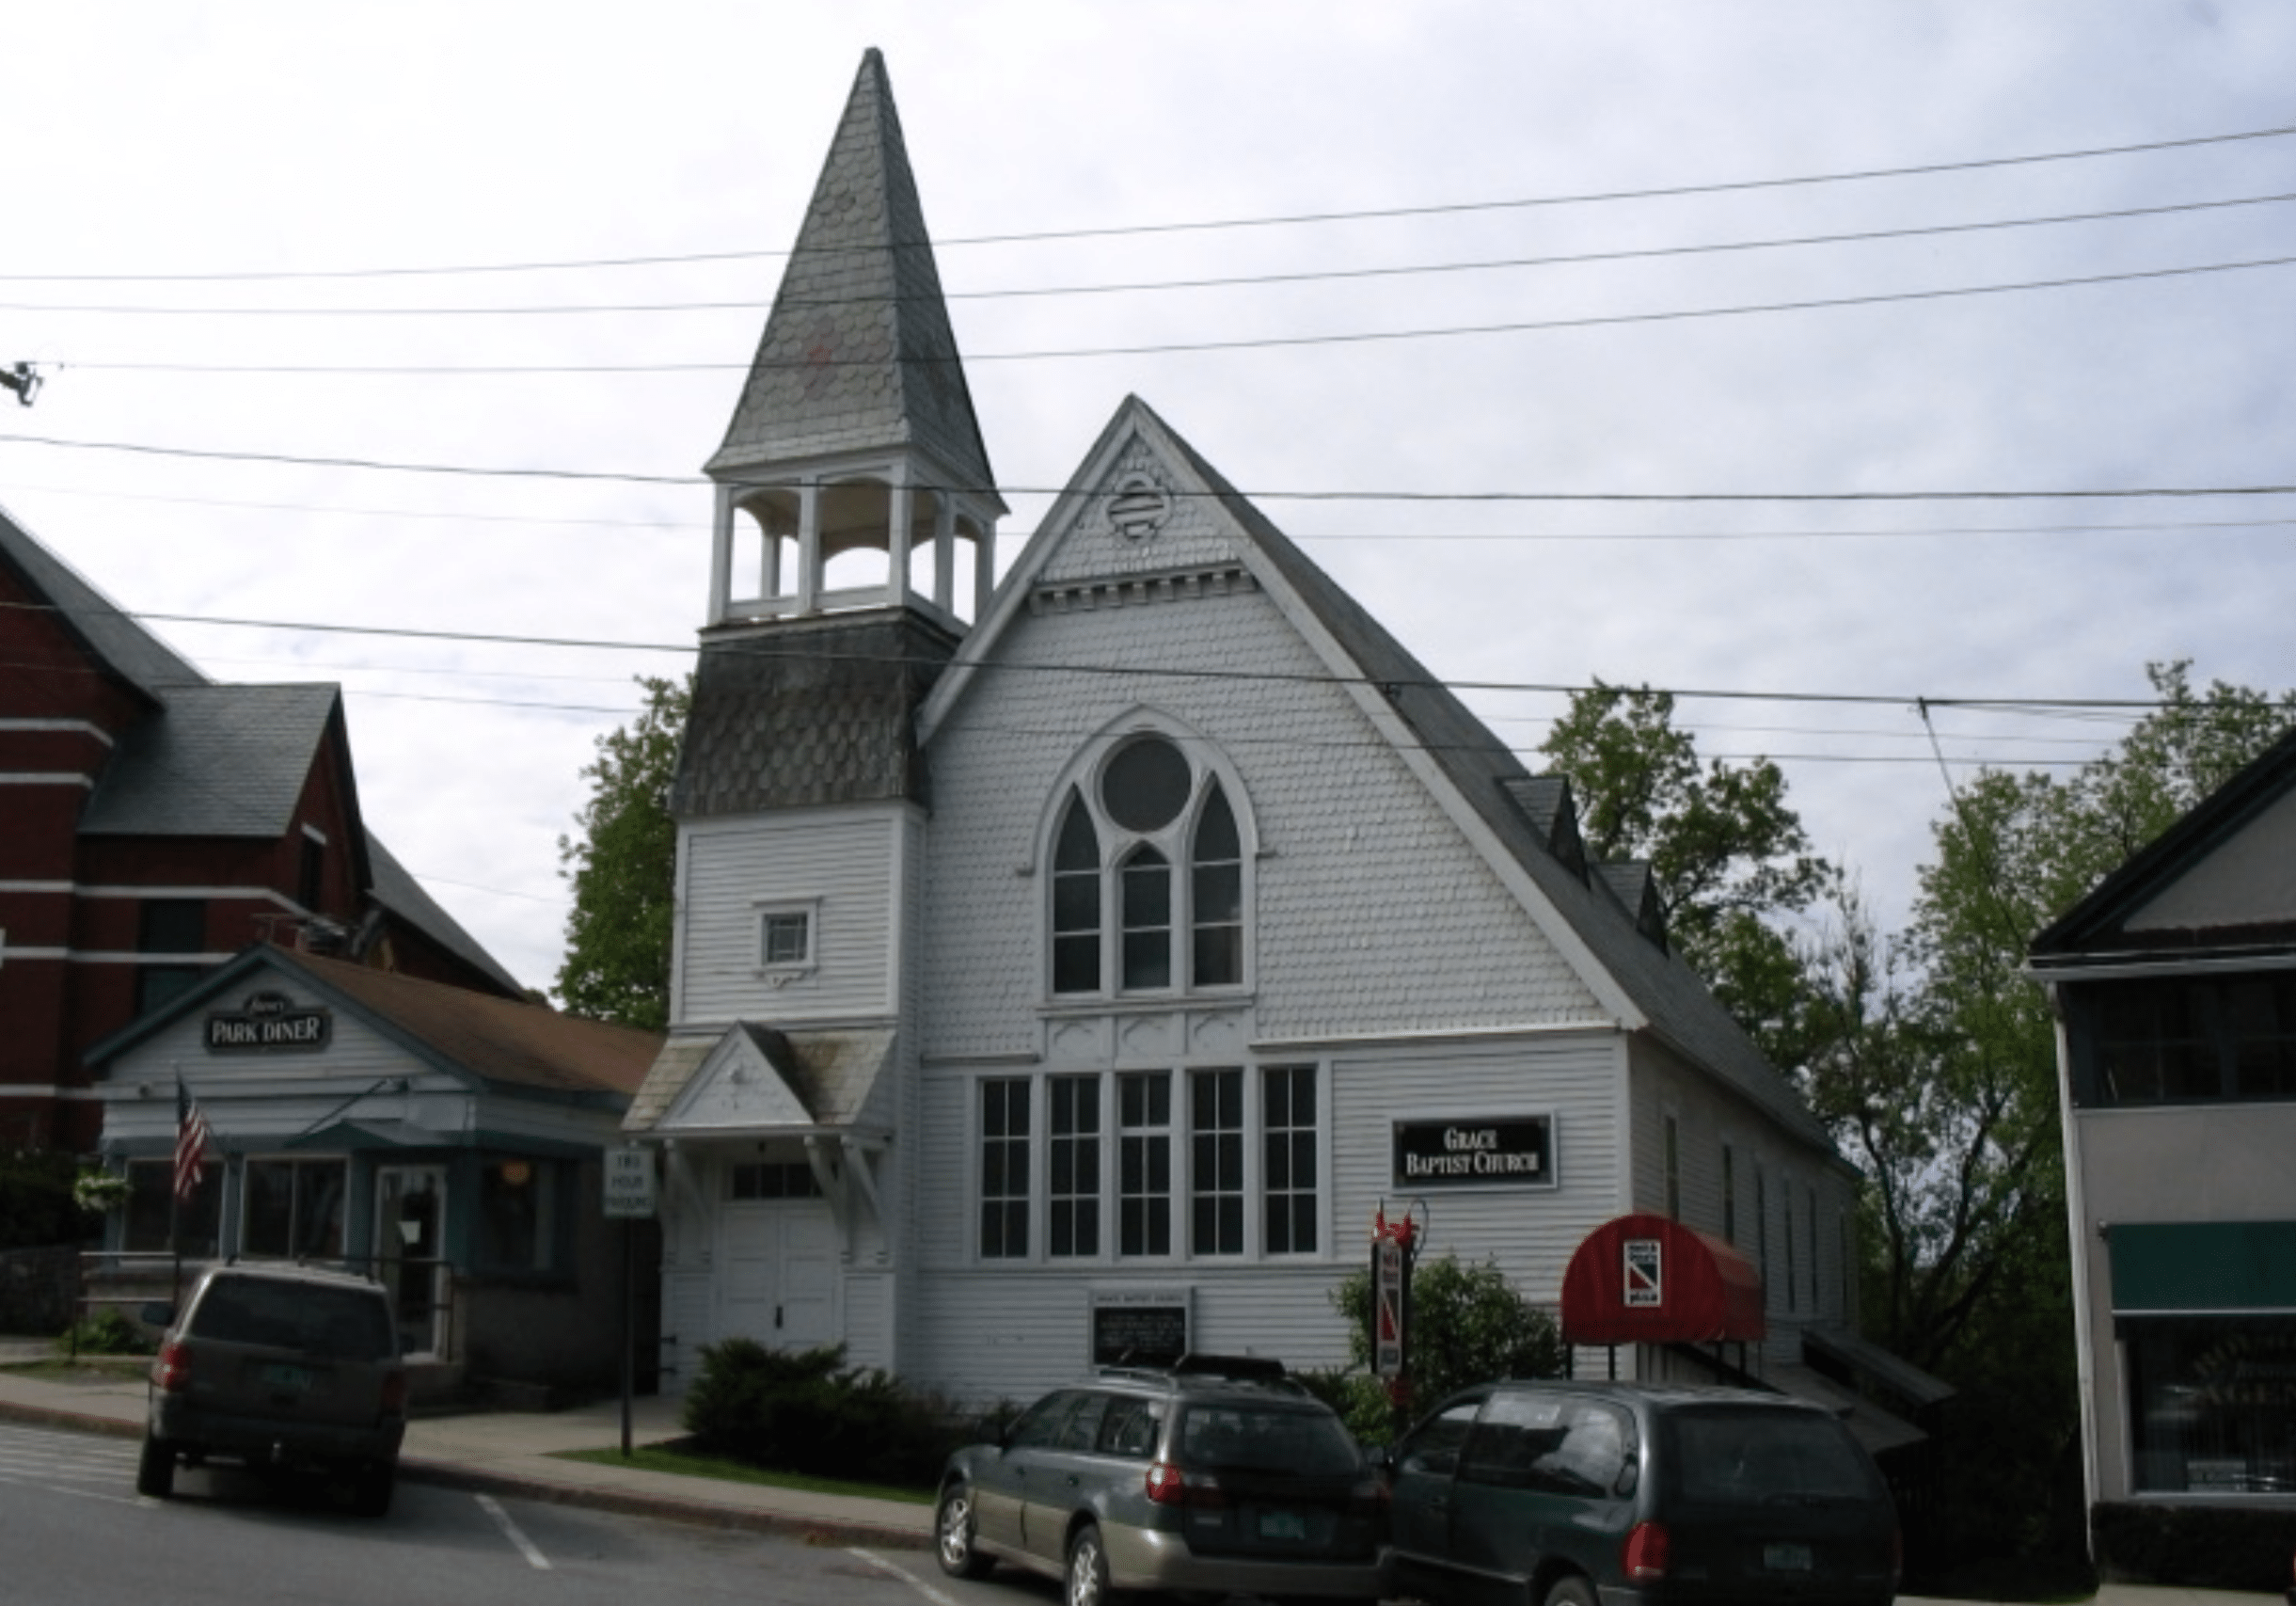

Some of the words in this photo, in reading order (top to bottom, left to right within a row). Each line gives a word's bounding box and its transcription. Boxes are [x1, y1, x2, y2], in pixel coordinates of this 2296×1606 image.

[212, 1020, 258, 1044] PARK
[262, 1016, 321, 1042] DINER
[1443, 1126, 1497, 1151] GRACE
[1405, 1153, 1471, 1177] BAPTIST
[1473, 1151, 1540, 1173] CHURCH
